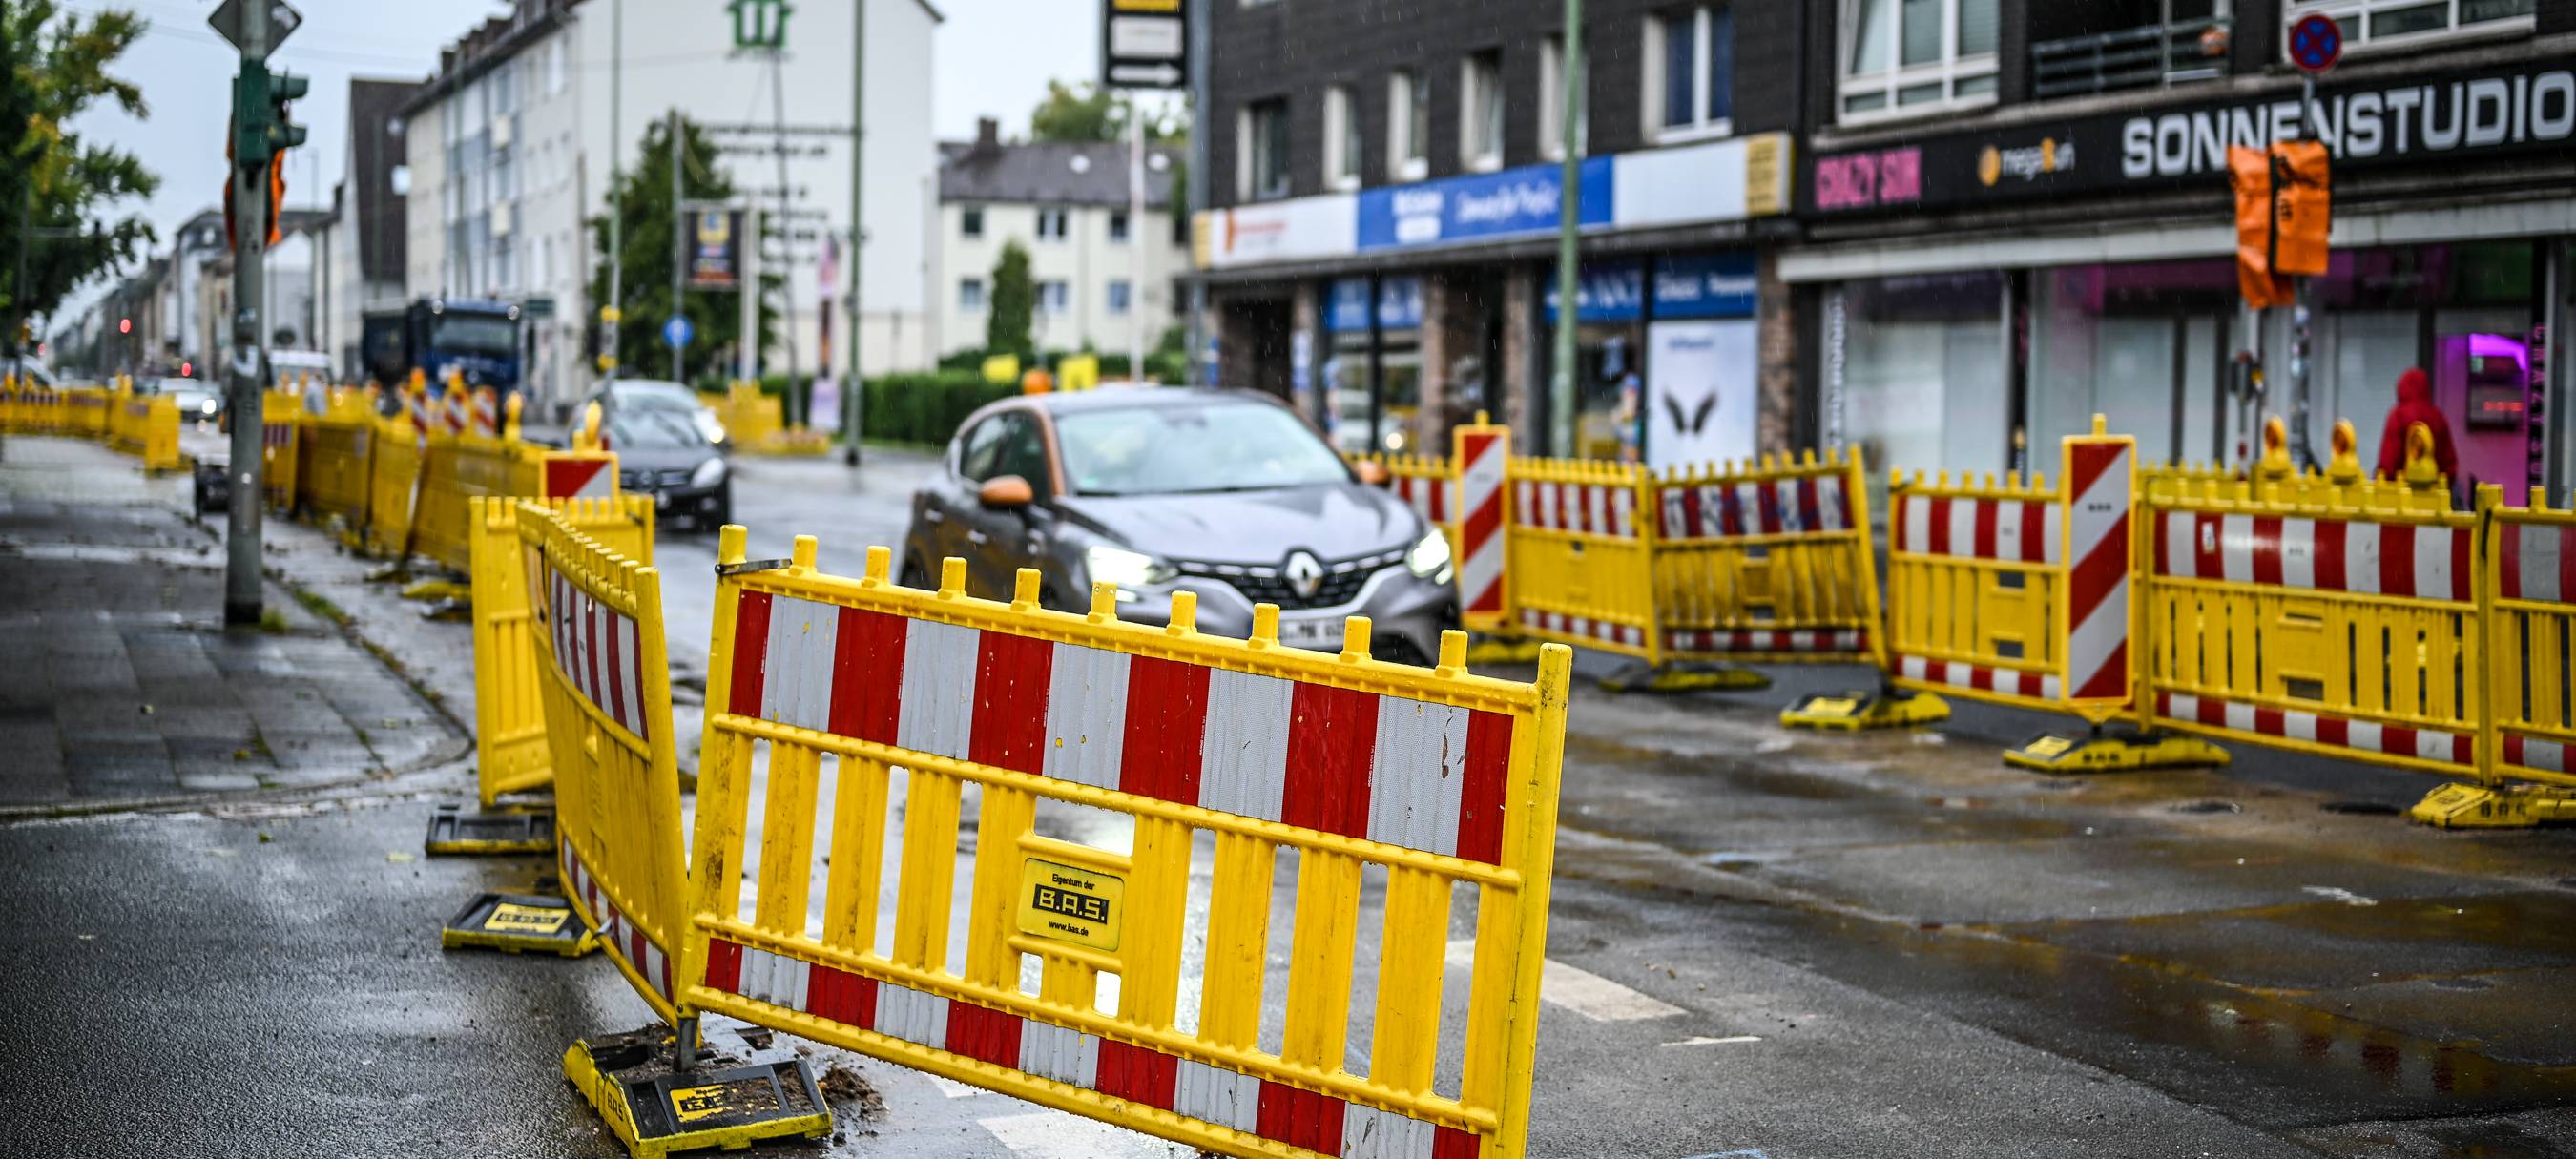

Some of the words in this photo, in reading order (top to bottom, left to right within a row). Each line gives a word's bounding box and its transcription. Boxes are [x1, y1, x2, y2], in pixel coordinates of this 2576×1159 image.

[2121, 70, 2576, 179] SONNENSTUDIO
[1051, 873, 1083, 888] Eigentum
[1084, 880, 1095, 891] der
[1039, 888, 1106, 921] B.A.S.
[1049, 921, 1090, 937] www.bas.de
